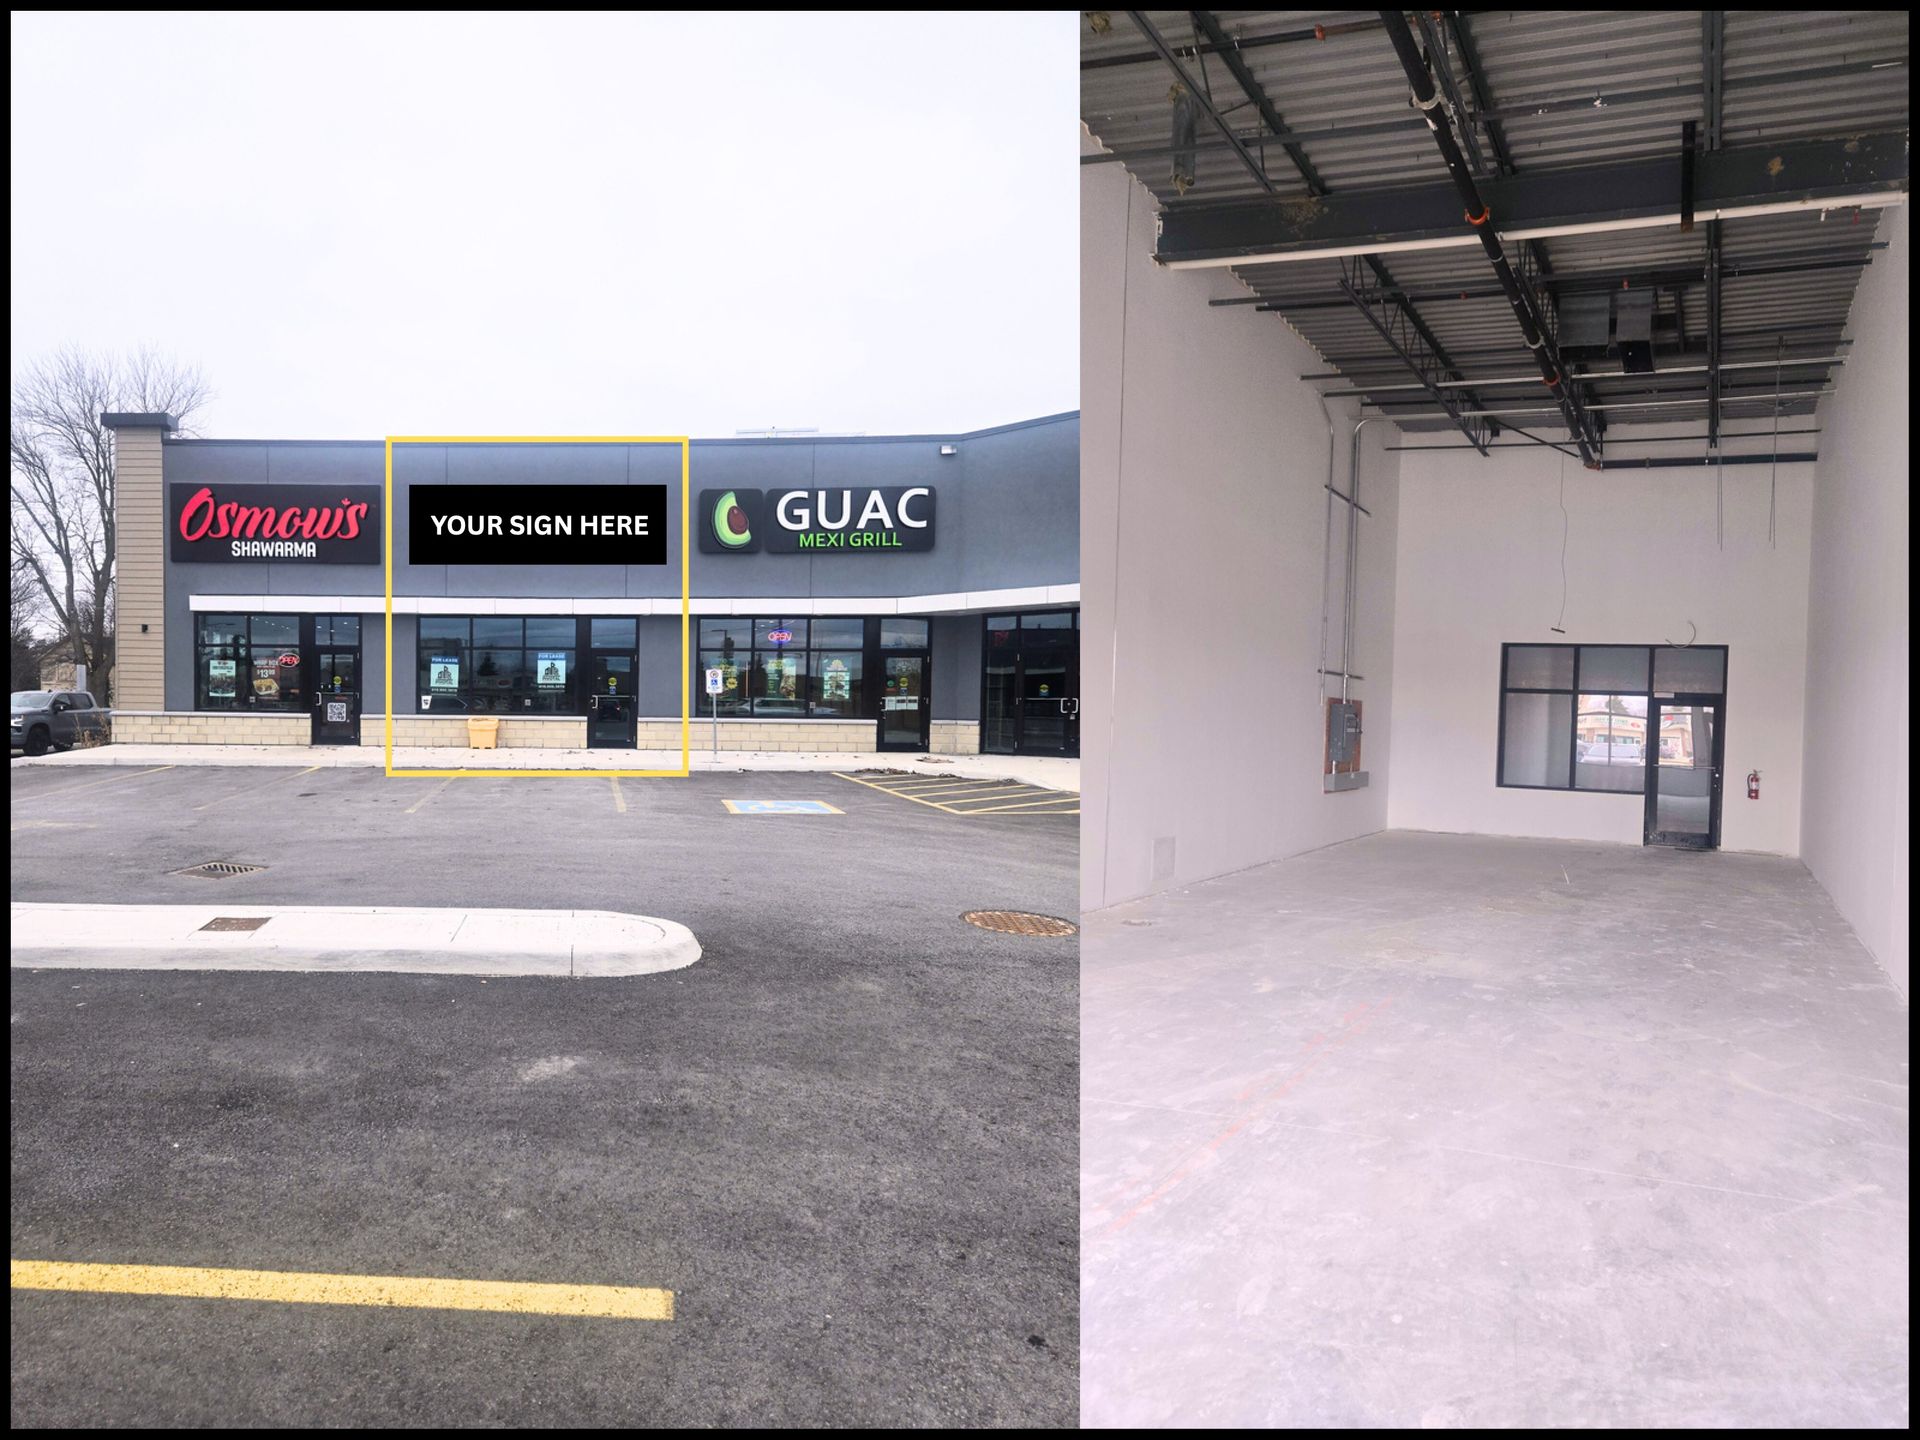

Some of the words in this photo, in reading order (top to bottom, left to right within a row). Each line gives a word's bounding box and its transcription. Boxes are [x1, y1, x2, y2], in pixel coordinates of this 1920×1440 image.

[776, 487, 929, 531] GUAC
[799, 533, 844, 548] MEXI
[849, 532, 903, 547] GRILL
[231, 540, 317, 558] SHAWARMA
[768, 631, 792, 642] OPEN
[280, 656, 299, 664] OPEN
